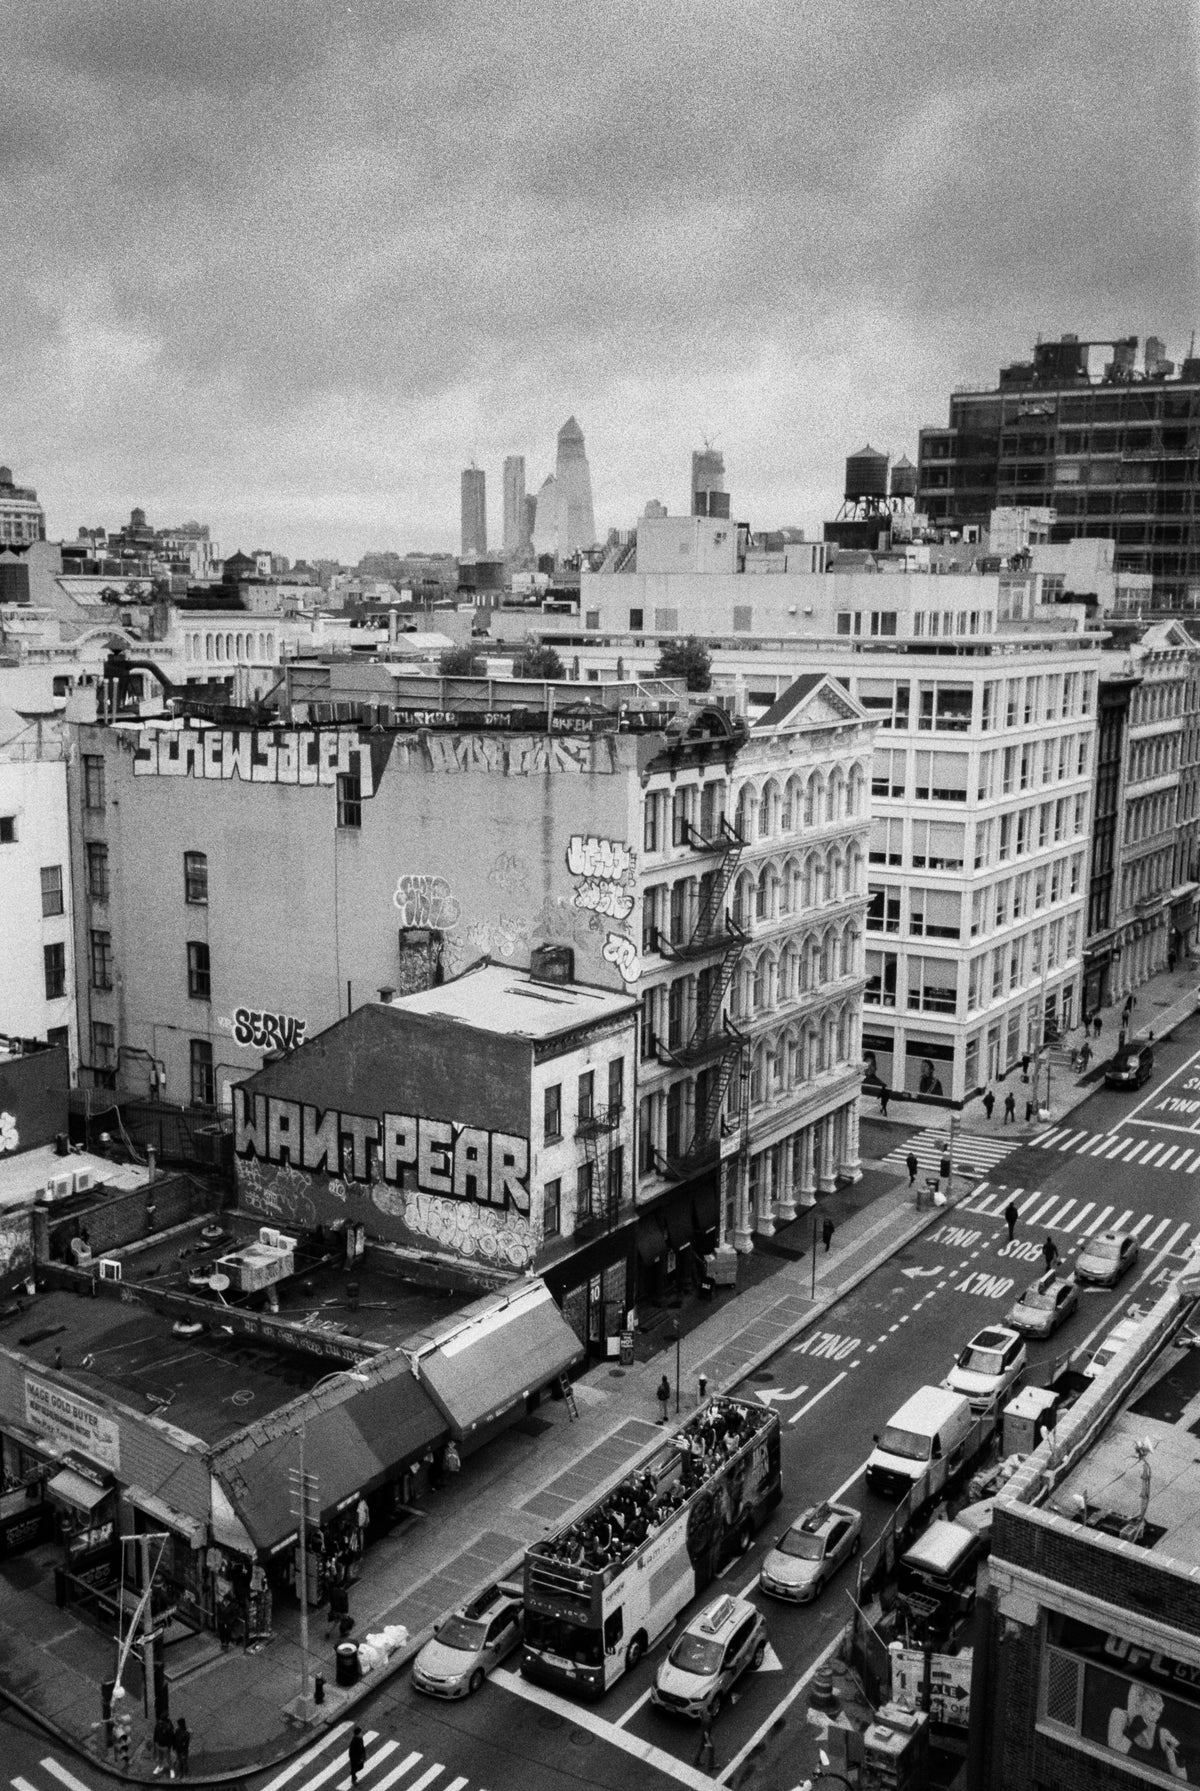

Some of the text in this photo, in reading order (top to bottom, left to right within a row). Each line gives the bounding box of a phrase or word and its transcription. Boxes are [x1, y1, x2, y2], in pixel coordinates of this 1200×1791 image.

[233, 1007, 307, 1051] SERVE
[382, 1111, 531, 1211] PEAR
[925, 1226, 982, 1249] ONLY
[997, 1239, 1045, 1263] BUS
[954, 1271, 1015, 1299] ONLY
[791, 1331, 861, 1361] ONLY
